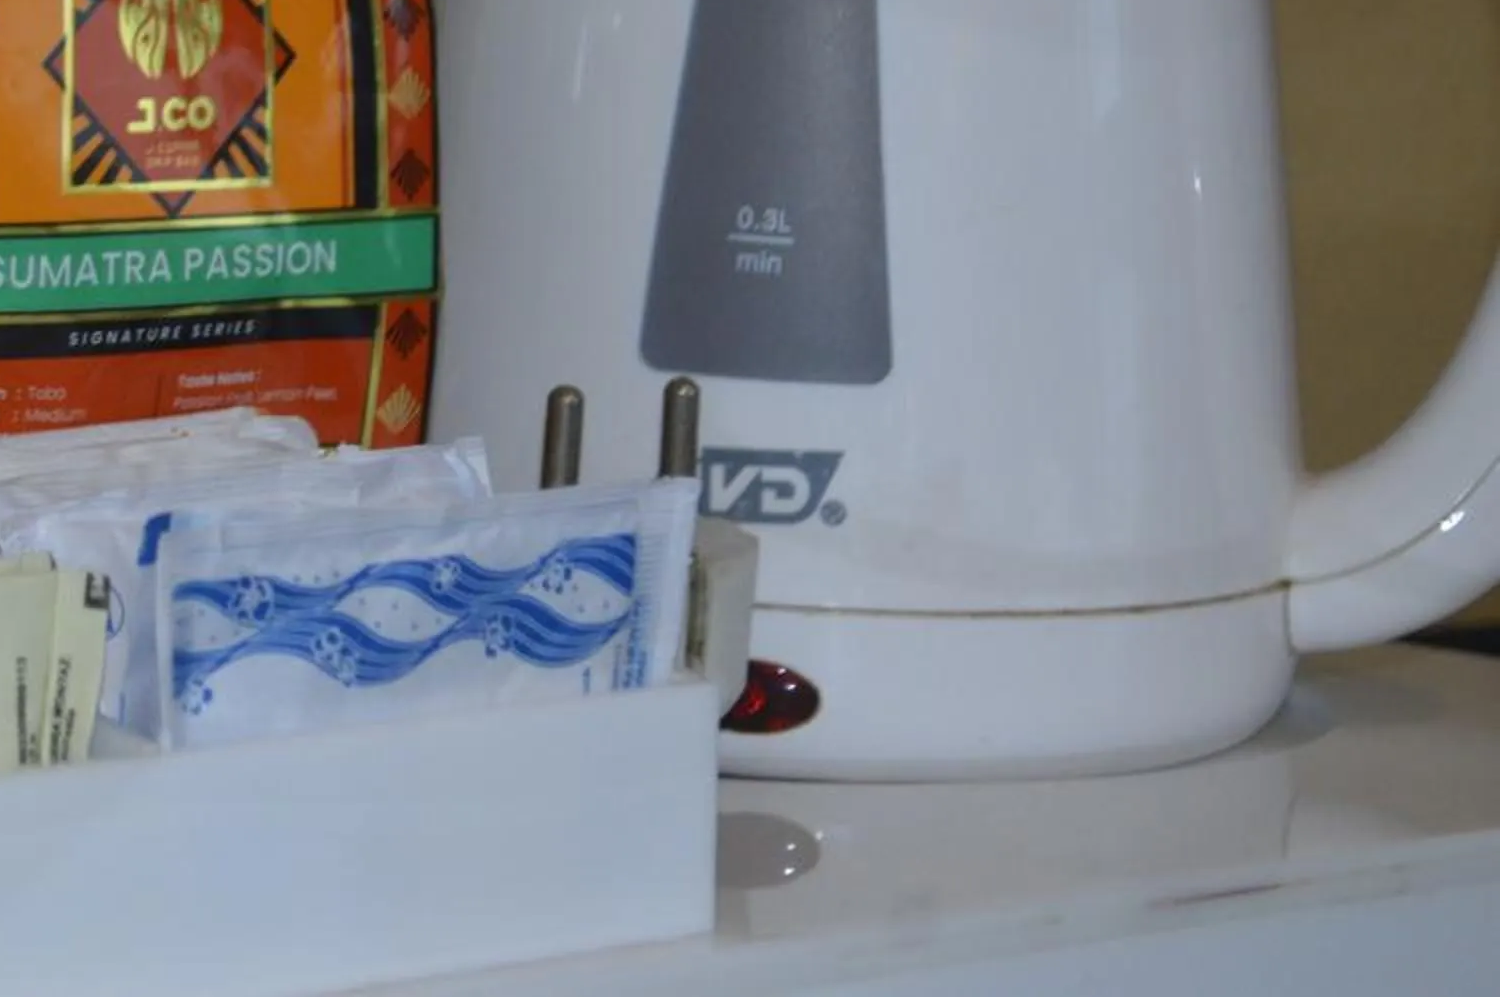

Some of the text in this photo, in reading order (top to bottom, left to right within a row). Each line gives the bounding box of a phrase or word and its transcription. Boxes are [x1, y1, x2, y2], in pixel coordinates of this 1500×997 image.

[736, 204, 792, 233] 0.3L
[184, 240, 337, 281] PASSION
[735, 250, 782, 276] min
[68, 319, 257, 347] SIGNATURE SERIES
[25, 407, 88, 423] Medium
